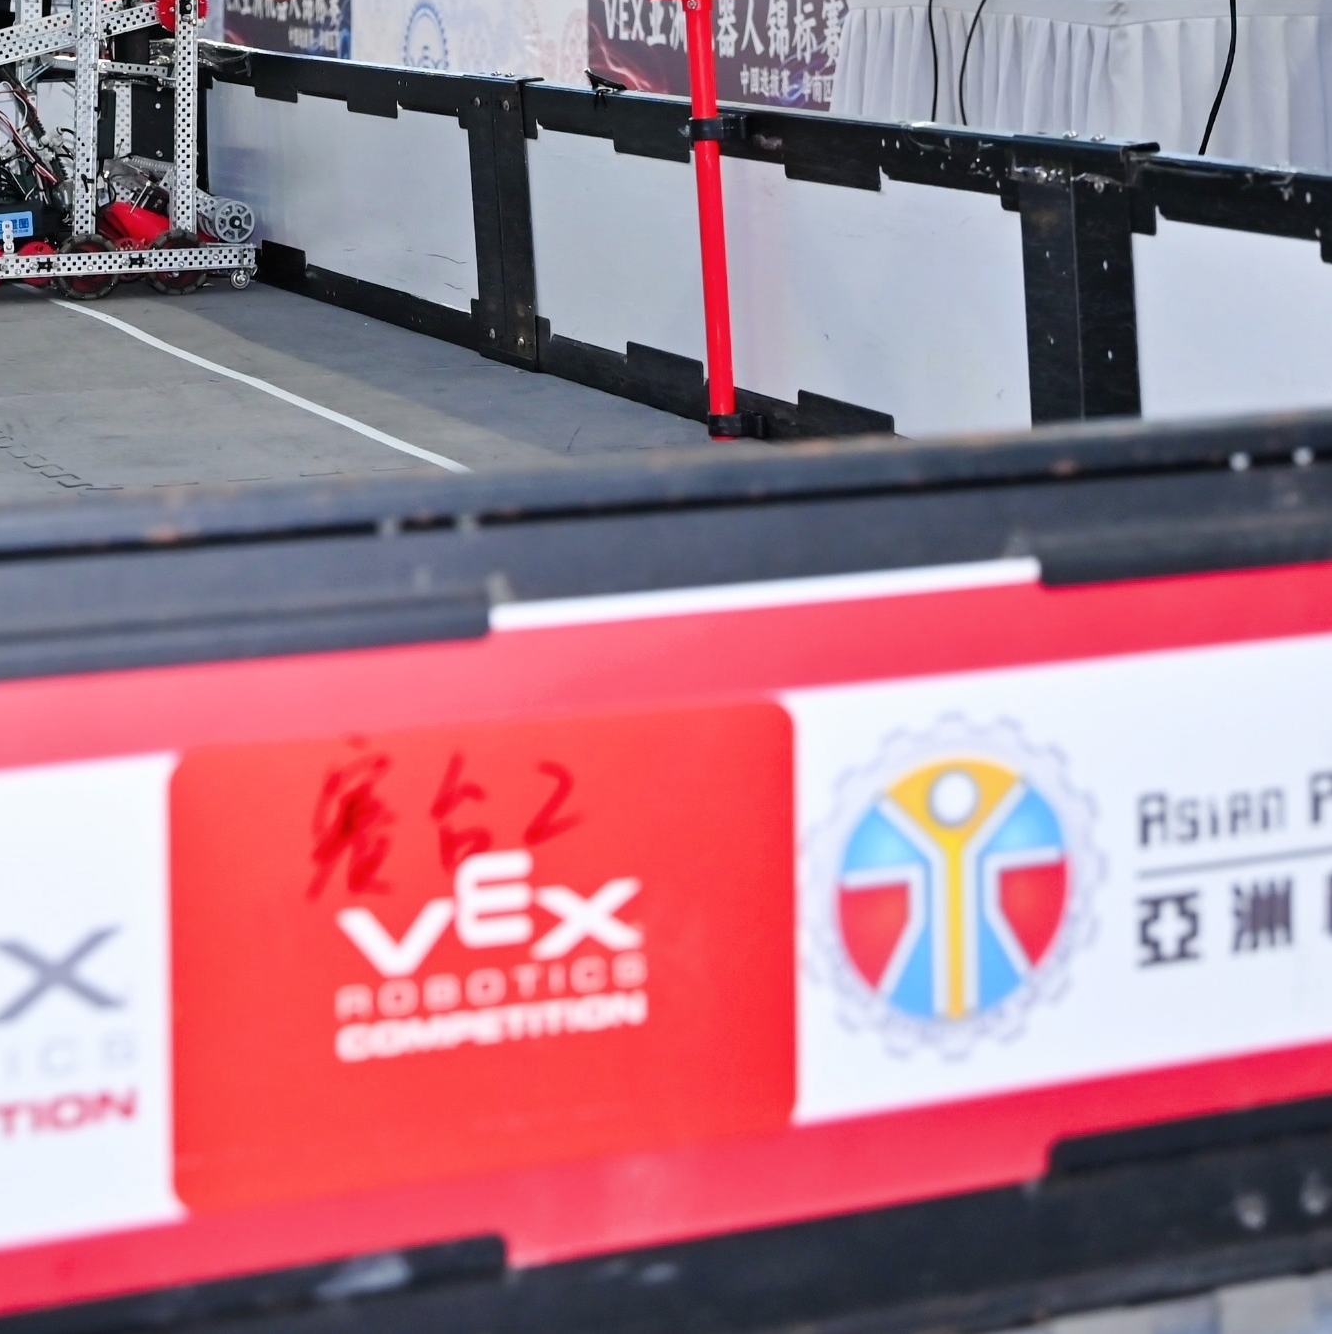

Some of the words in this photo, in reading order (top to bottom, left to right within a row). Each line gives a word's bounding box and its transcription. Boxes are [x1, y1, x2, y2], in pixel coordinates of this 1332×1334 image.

[334, 847, 644, 978] VEX
[333, 949, 650, 1021] ROBOTICS
[333, 988, 650, 1064] COMPETITION
